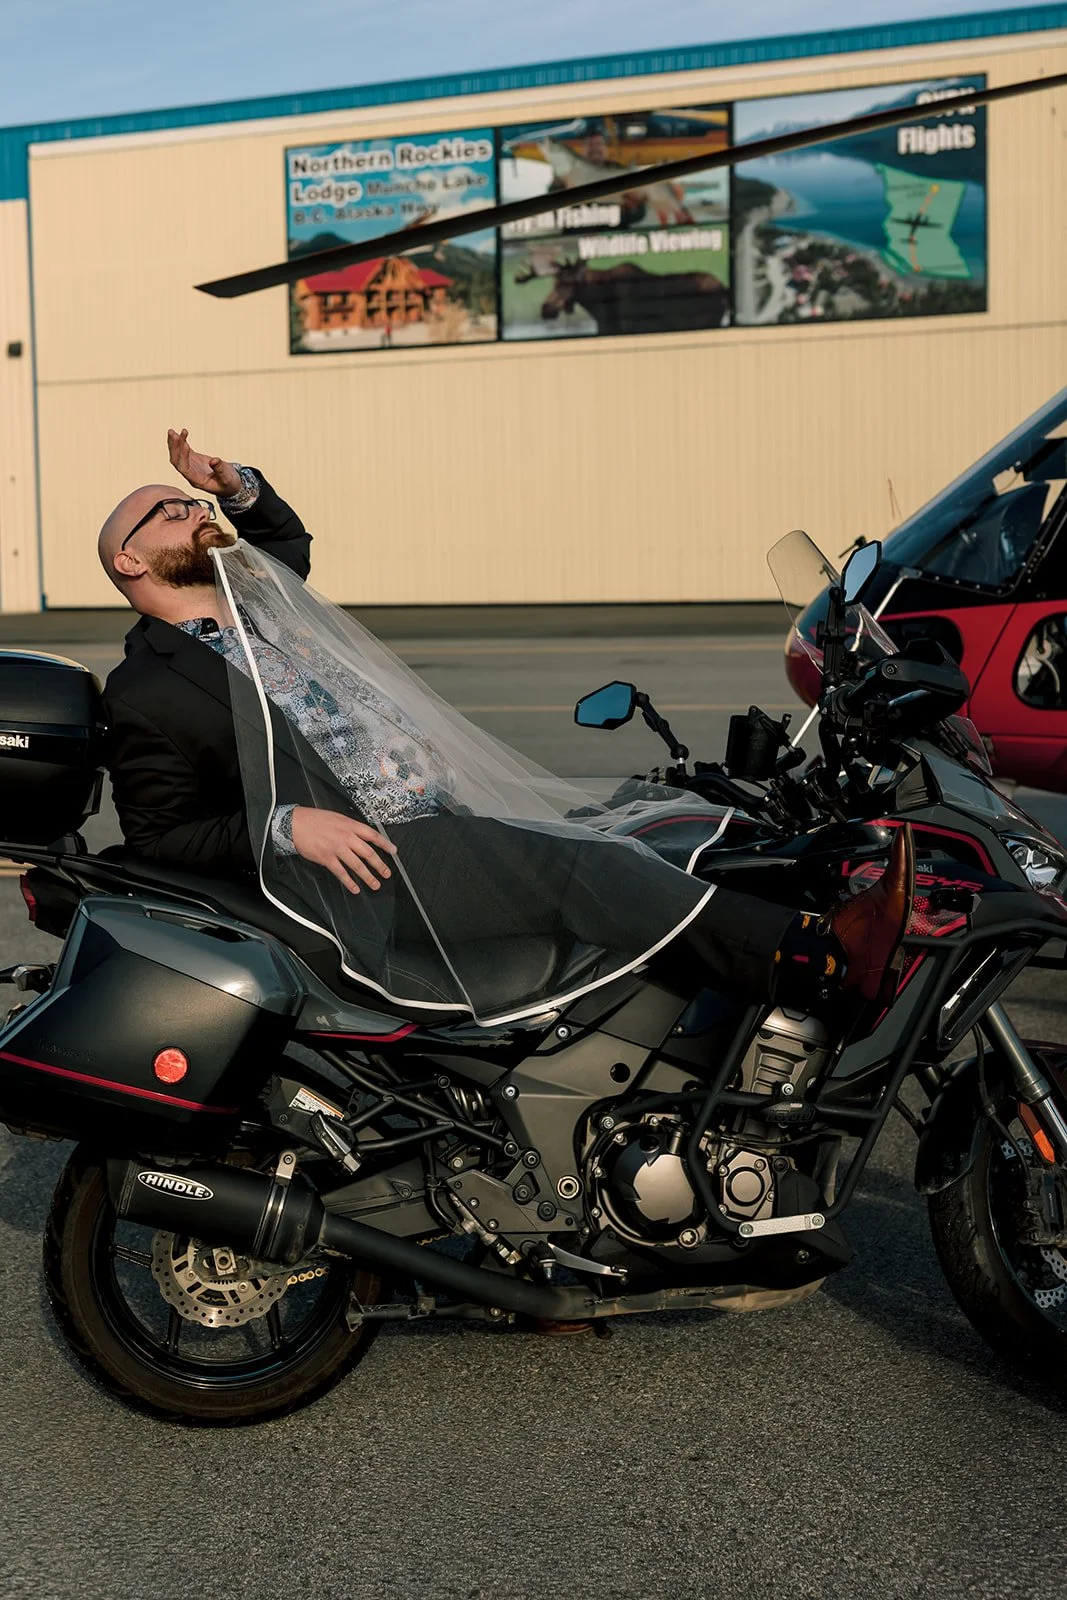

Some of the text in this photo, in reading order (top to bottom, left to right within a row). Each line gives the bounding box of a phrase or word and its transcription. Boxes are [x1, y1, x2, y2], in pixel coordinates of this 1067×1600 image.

[897, 123, 976, 155] Flights
[292, 139, 490, 175] Northern Rockies
[292, 182, 360, 205] Lodge
[442, 172, 488, 189] Lake
[335, 203, 395, 222] Alaska
[556, 203, 621, 228] Fishing
[577, 228, 722, 260] Wildlife Viewing
[915, 863, 933, 874] aki
[145, 1174, 206, 1198] HINDLE
